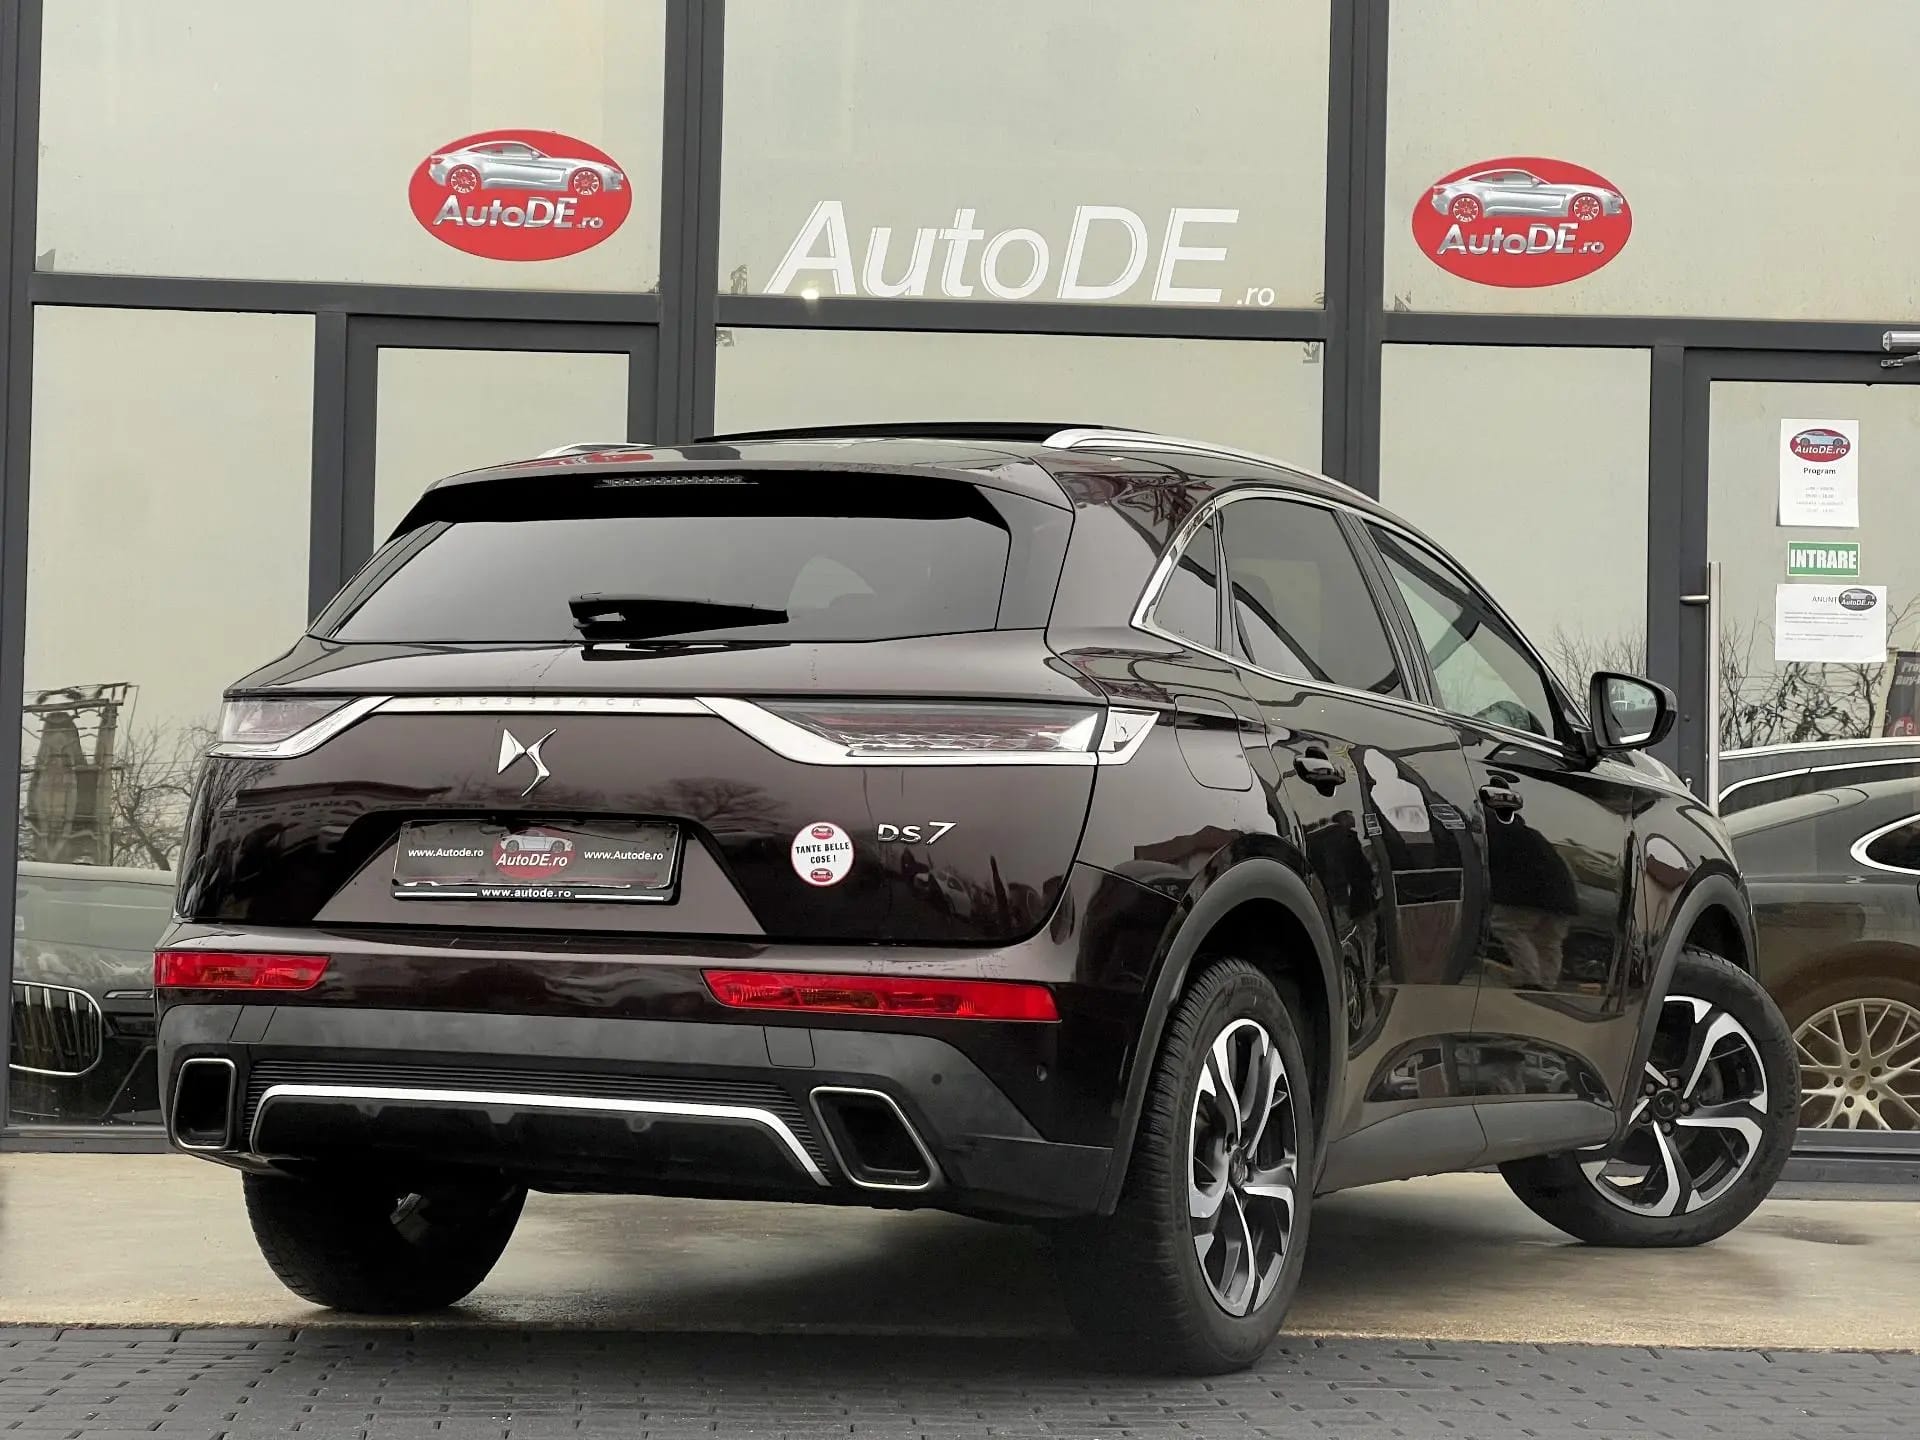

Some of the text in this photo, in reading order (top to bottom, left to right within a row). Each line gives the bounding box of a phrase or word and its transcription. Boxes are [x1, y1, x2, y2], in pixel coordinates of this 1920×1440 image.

[1794, 445, 1847, 455] AutoDE.ro
[1803, 467, 1837, 476] Program
[1790, 549, 1857, 569] INTRARE
[432, 697, 642, 708] CROSSBACK
[408, 847, 484, 859] www.Autode.ro
[795, 842, 849, 854] TANTE BELLE
[496, 852, 568, 868] AutoDE.ro
[584, 849, 664, 861] www.Autode.ro
[810, 854, 831, 864] COSE
[481, 886, 572, 899] www.autode.ro
